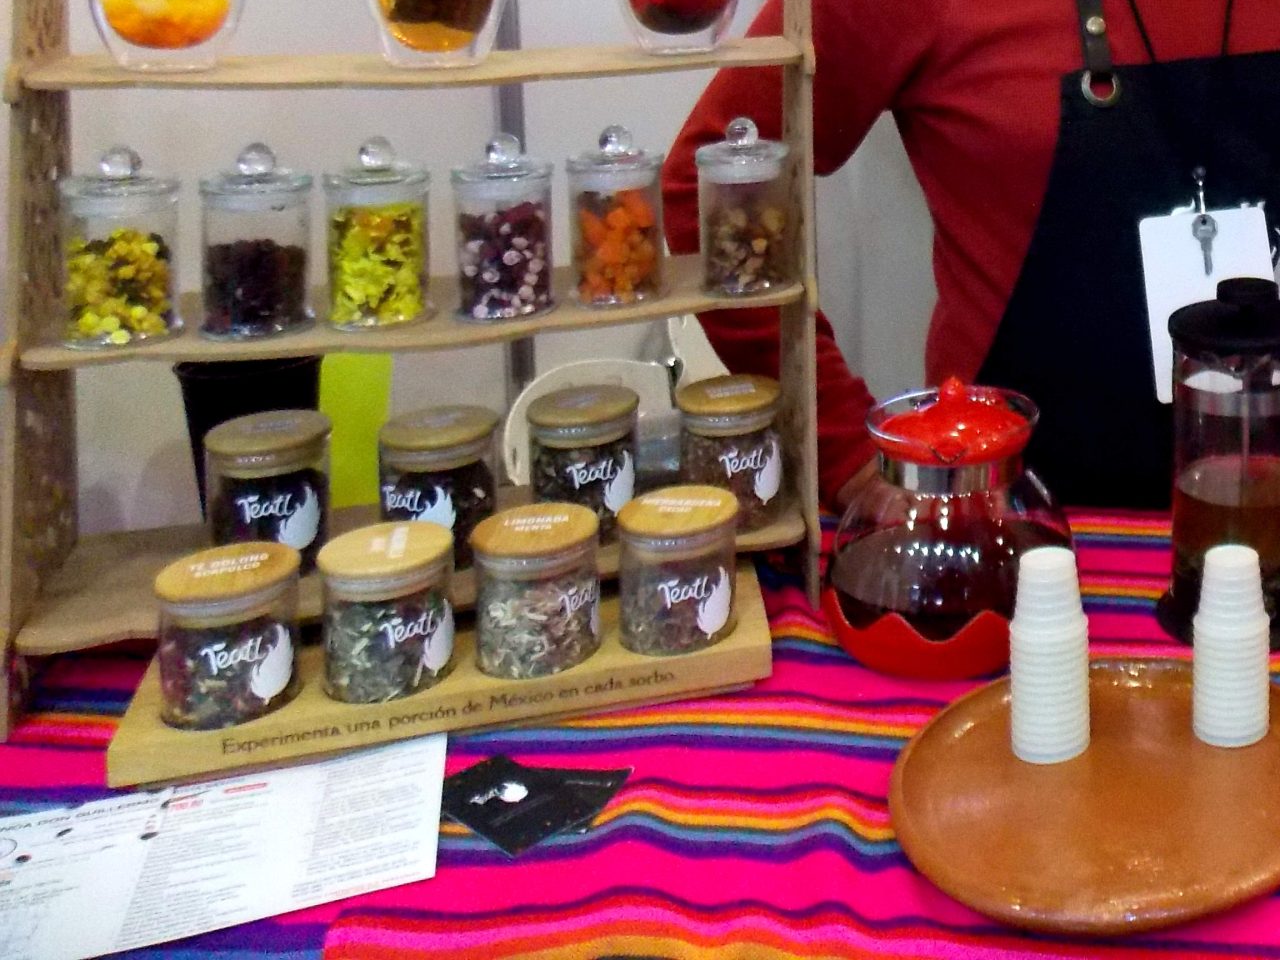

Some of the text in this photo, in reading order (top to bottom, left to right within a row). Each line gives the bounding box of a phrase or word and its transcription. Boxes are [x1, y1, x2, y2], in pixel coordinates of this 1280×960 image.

[222, 725, 342, 755] Experimenta
[348, 718, 382, 734] una
[389, 705, 457, 730] porción
[462, 700, 482, 715] de
[559, 686, 580, 699] en
[585, 677, 623, 695] cada
